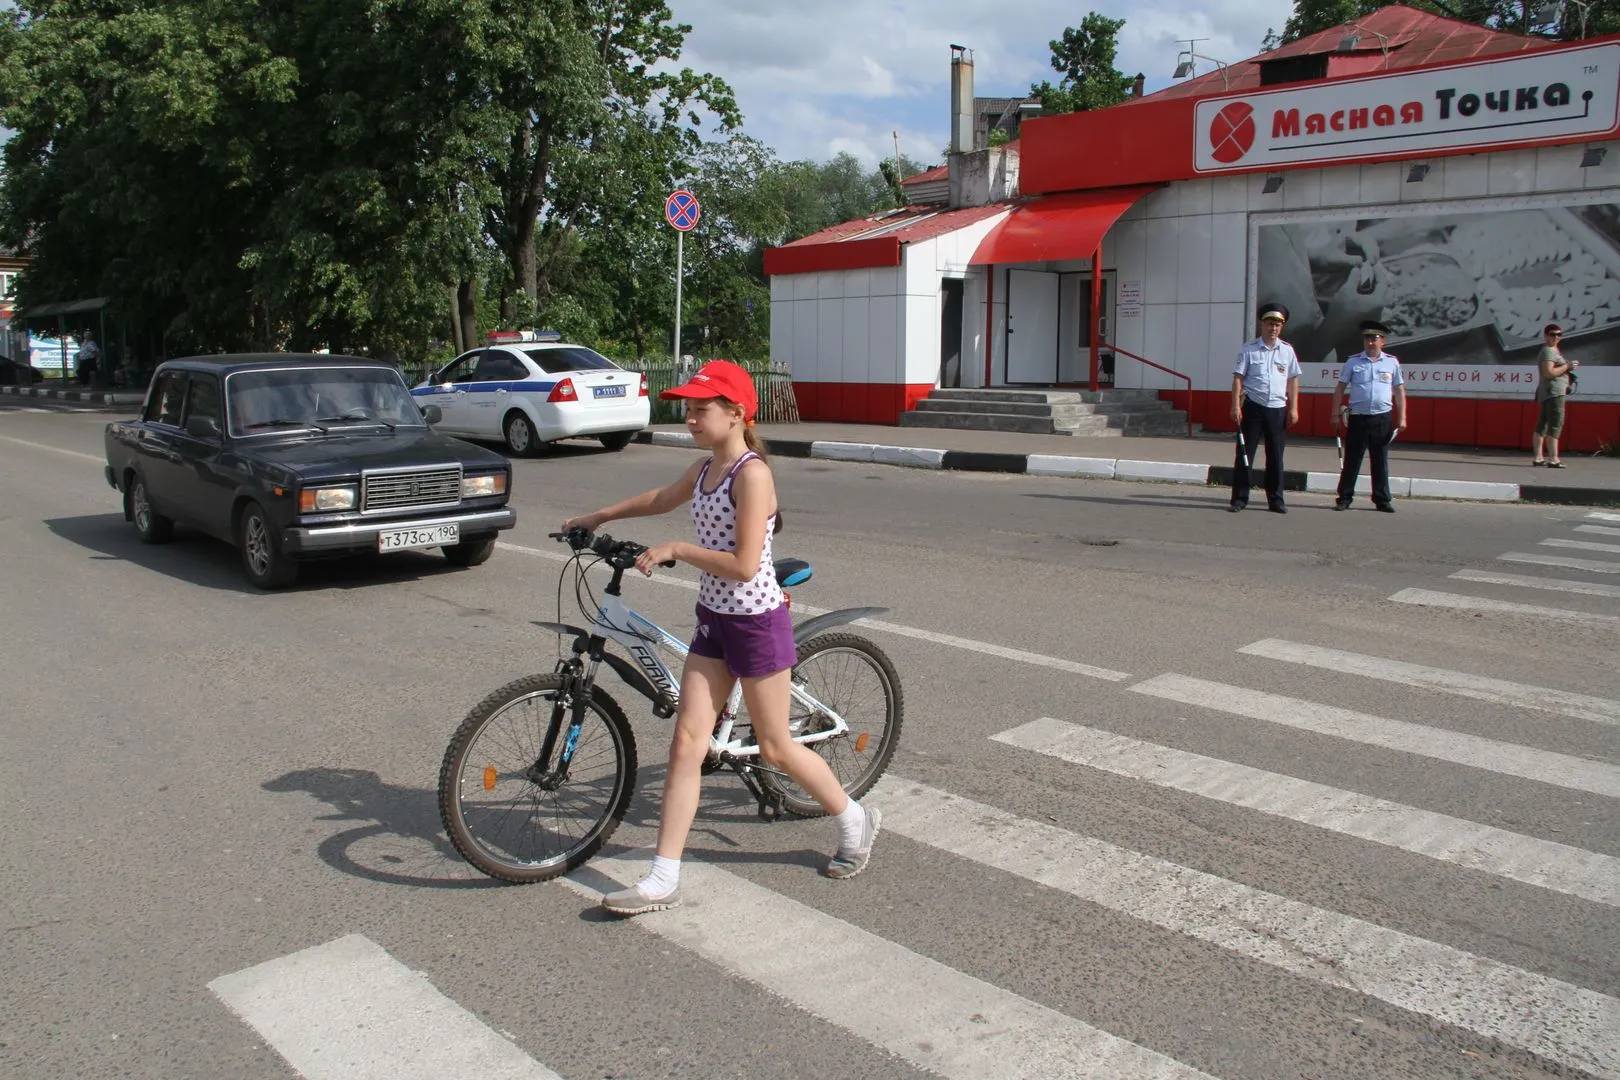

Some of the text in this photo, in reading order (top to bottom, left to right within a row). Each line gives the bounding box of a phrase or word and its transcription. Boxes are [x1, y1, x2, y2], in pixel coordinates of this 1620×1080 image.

[1271, 82, 1570, 138] Мясная Точка
[1494, 372, 1533, 383] ЖИЗ
